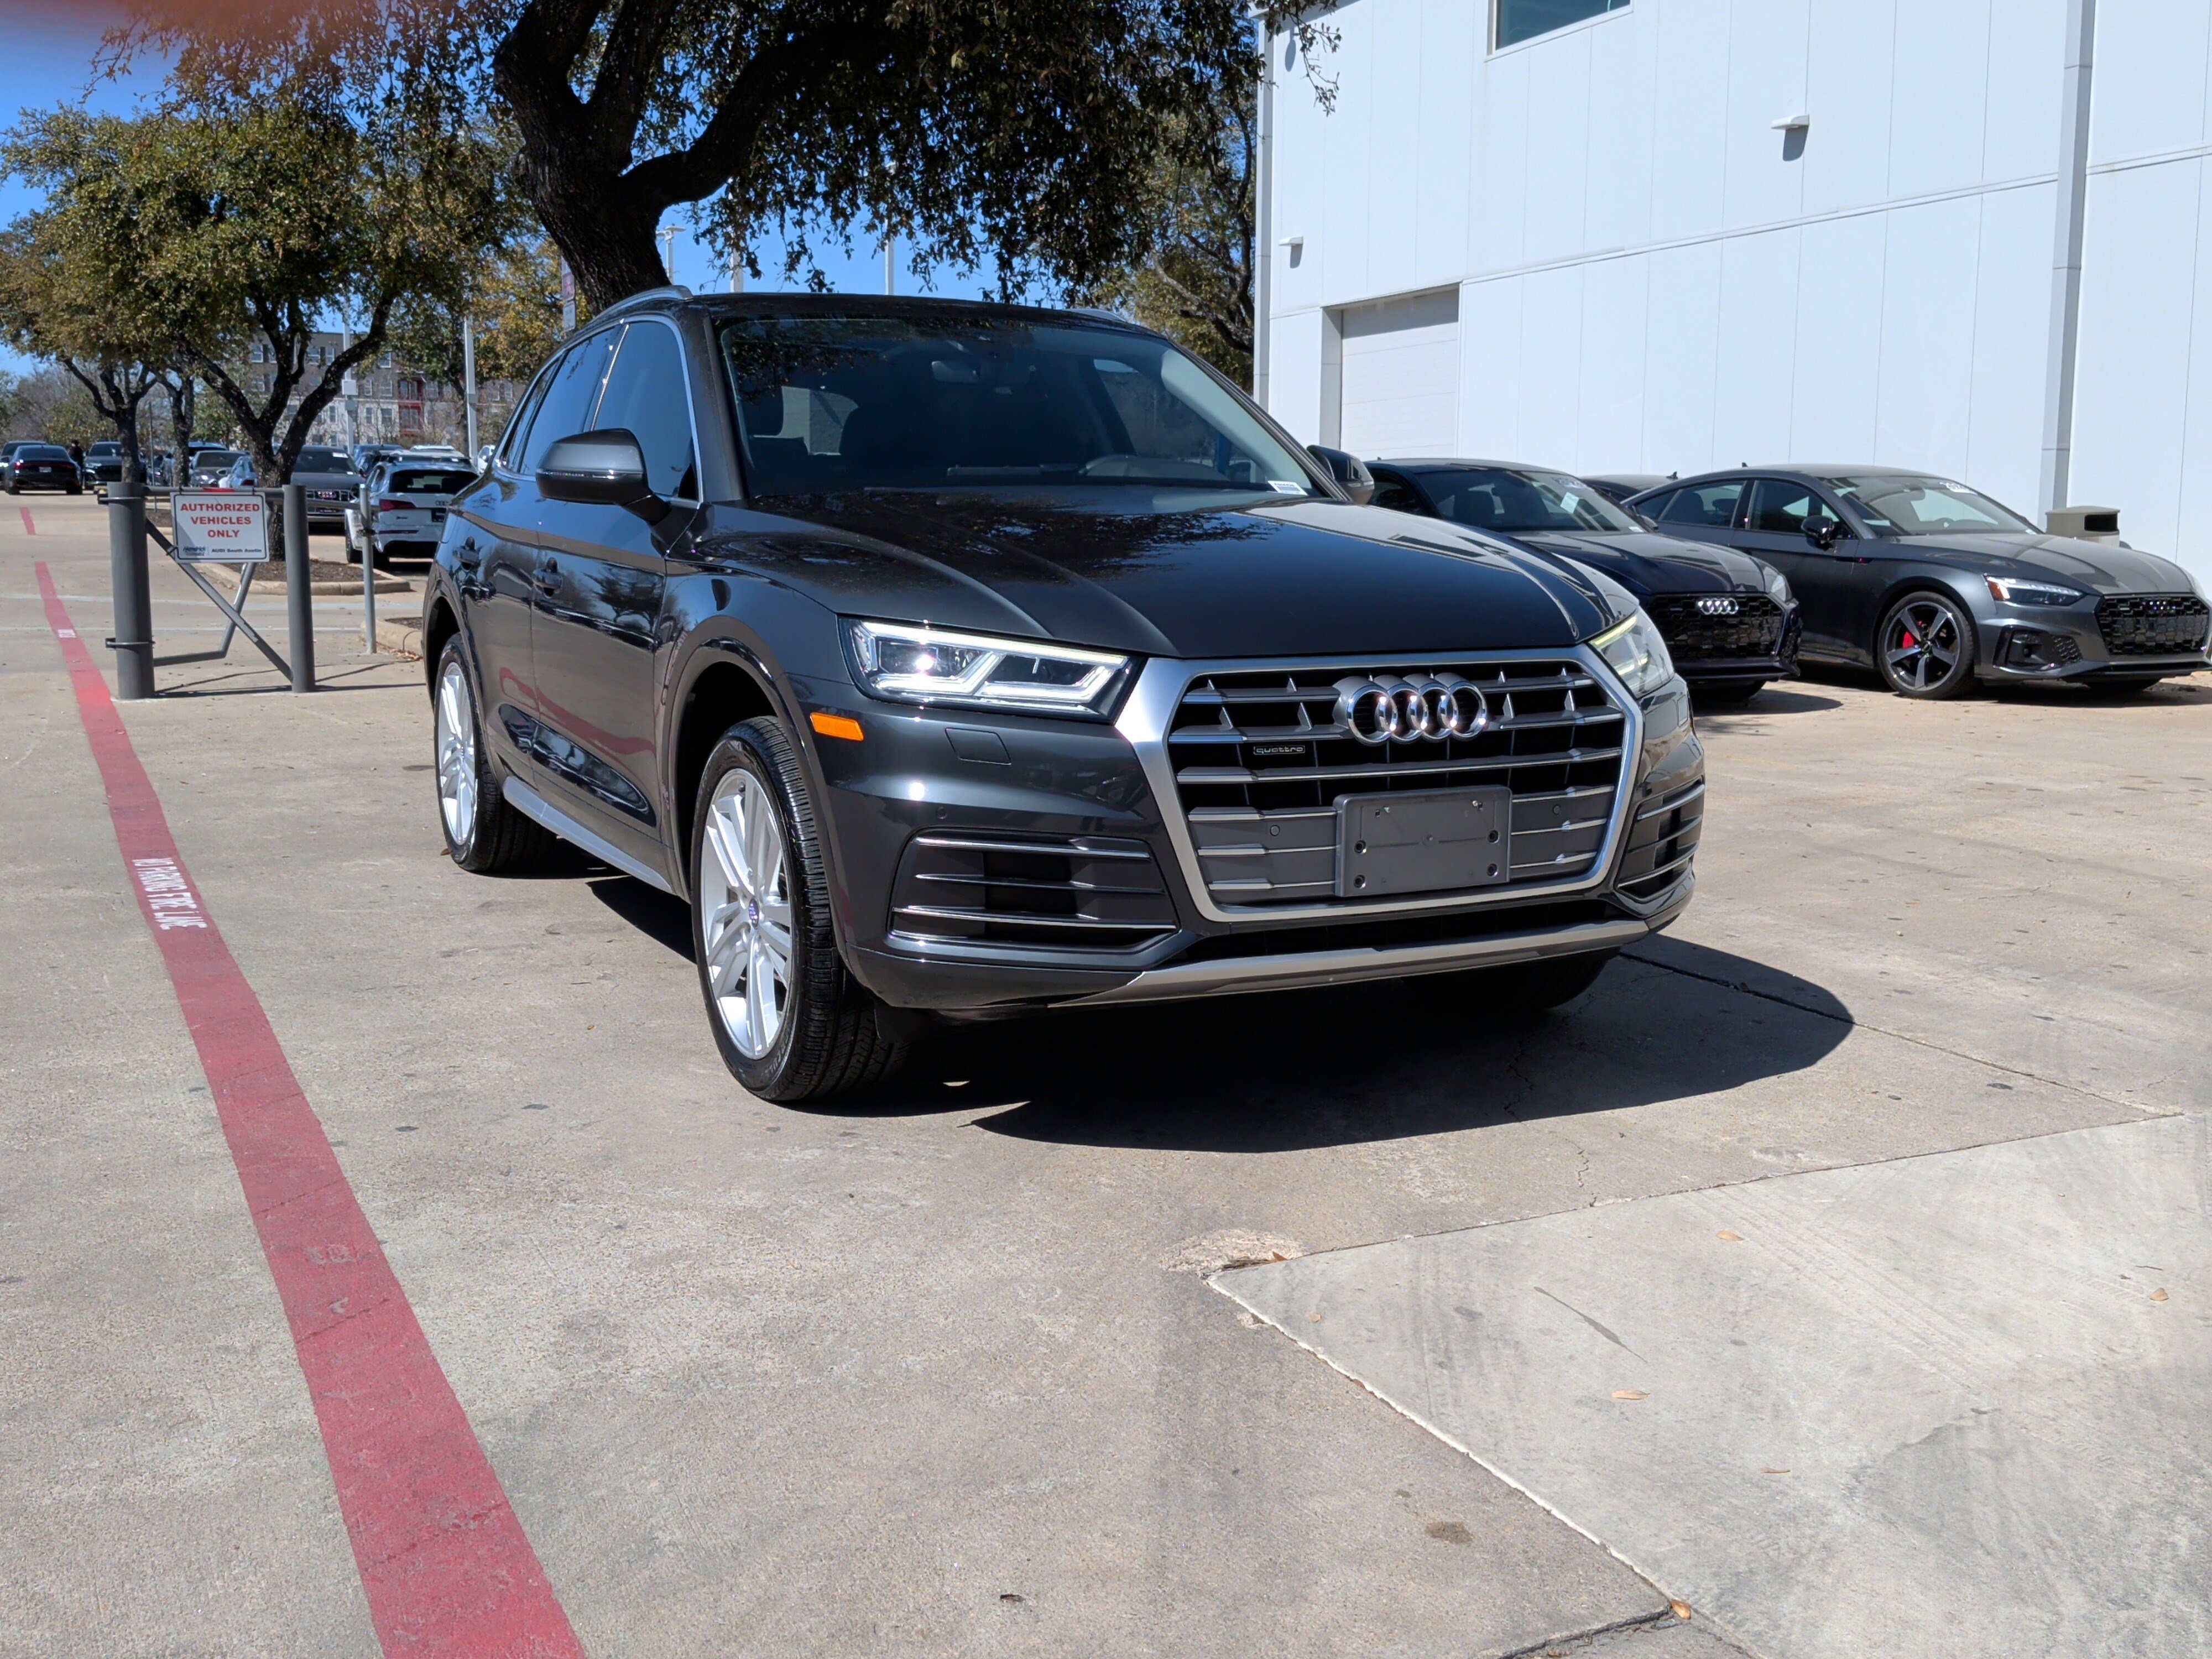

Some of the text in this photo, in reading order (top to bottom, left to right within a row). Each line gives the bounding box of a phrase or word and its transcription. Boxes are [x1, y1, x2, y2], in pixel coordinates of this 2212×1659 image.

[180, 503, 260, 512] AUTHORIZED
[191, 517, 251, 525] VEHICLES
[132, 858, 207, 930] NO PARKING FIRE LANE
